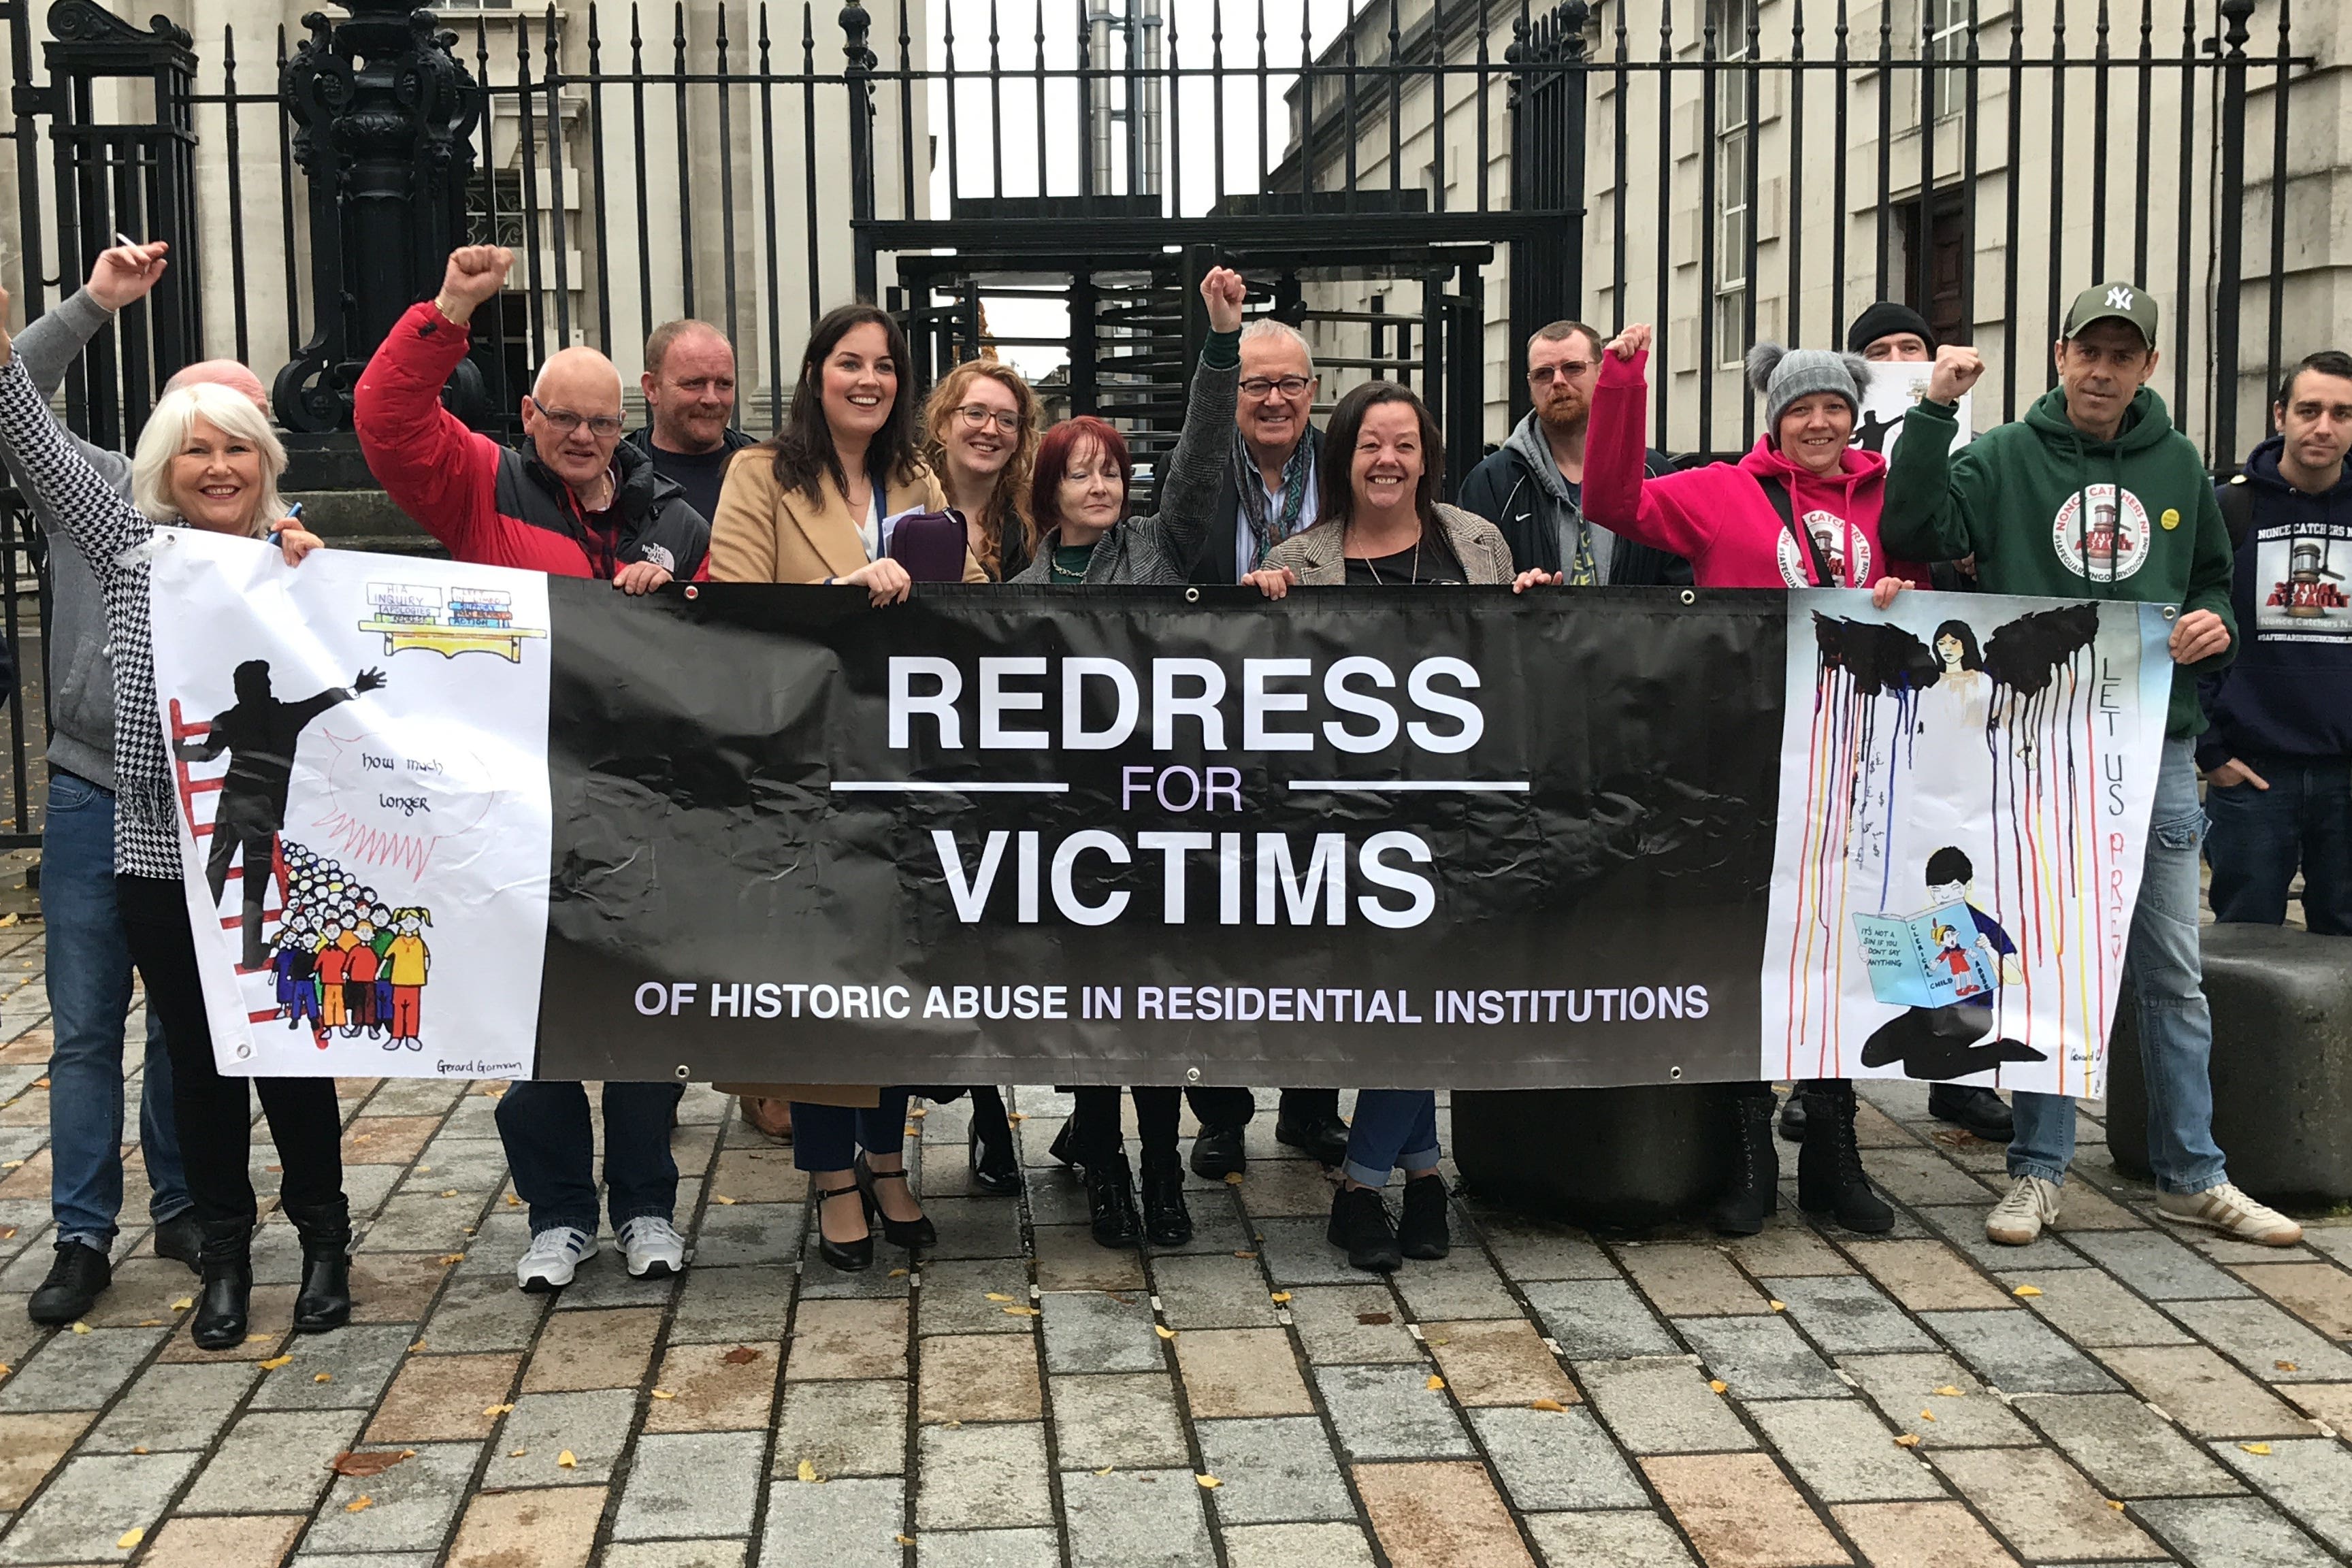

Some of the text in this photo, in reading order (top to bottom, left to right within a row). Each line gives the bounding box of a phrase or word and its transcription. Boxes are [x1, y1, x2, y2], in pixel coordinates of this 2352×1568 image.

[2104, 286, 2134, 311] NY
[2056, 487, 2149, 534] NONC CATHERS NI
[2257, 523, 2291, 540] NONCE
[1859, 545, 1869, 559] NI
[387, 585, 408, 593] HIA
[2274, 581, 2338, 595] SXUAL
[374, 594, 424, 606] INQUIRY
[383, 606, 431, 615] APOLOGIES
[454, 616, 488, 625] ACTION
[889, 656, 1484, 753] REDRESS
[2099, 657, 2122, 736] LET
[406, 758, 444, 776] much
[1122, 766, 1243, 812] FOR
[2104, 753, 2125, 816] US
[930, 830, 1435, 928] VICTIMS
[1863, 937, 1876, 946] SIN
[1886, 939, 1898, 947] YOU
[1875, 929, 1889, 938] NOT
[1889, 949, 1901, 957] SAY
[1910, 924, 1933, 978] CLERICAL
[1867, 958, 1903, 968] ANYTHING
[1929, 977, 1953, 990] CHILD
[1974, 960, 1991, 990] ABUSE
[634, 982, 1709, 1024] OF HISTORIC ABUSE IN RESIDENTIAL INSTITUTIONS
